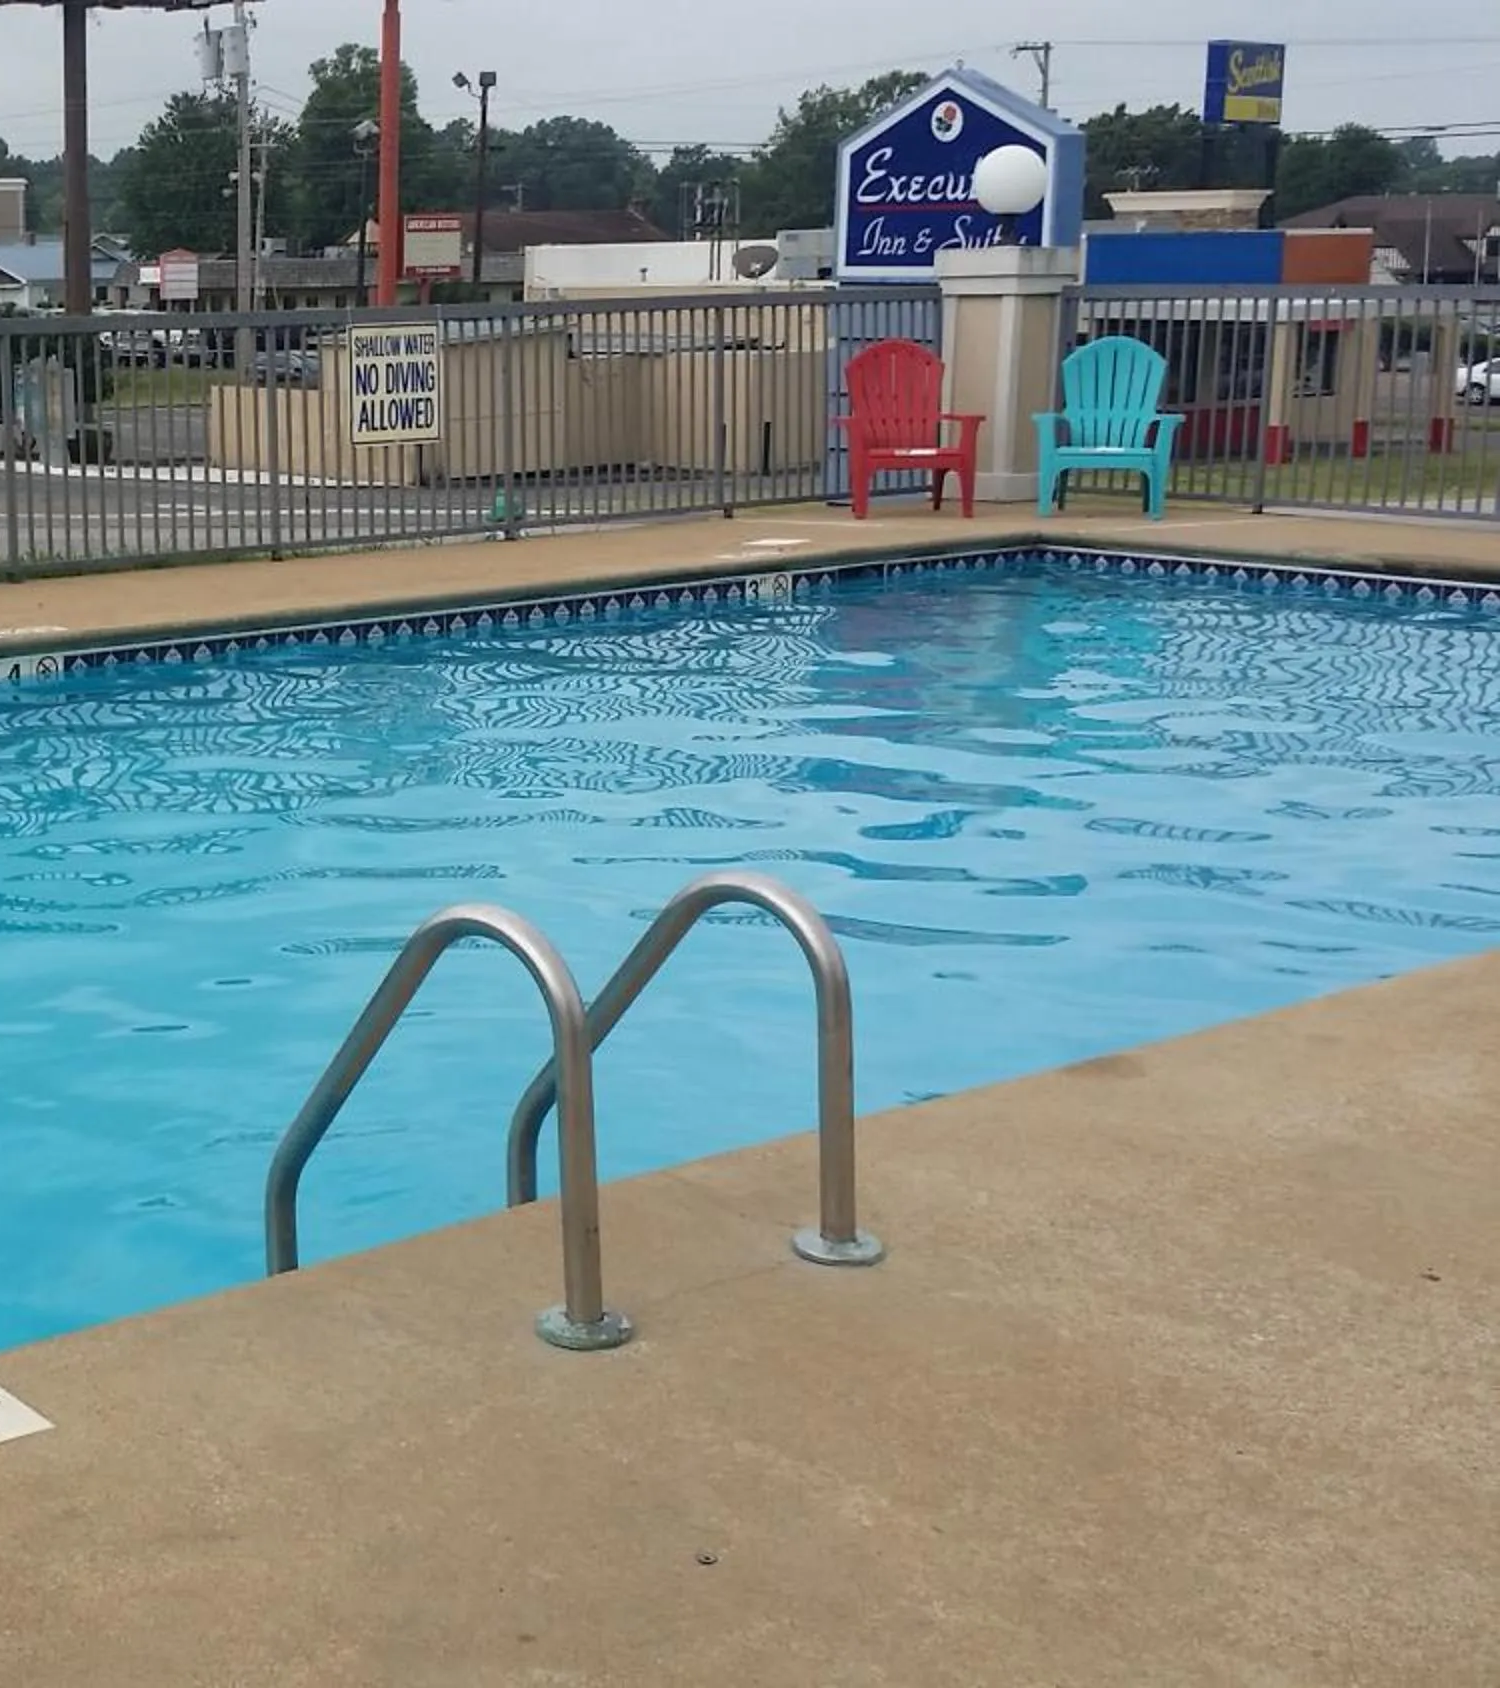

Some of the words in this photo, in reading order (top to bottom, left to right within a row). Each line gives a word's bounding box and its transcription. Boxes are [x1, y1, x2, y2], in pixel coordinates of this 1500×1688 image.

[857, 216, 907, 255] Inn
[914, 228, 933, 252] &
[354, 335, 400, 358] SHALLOW
[404, 333, 435, 356] WATER
[355, 363, 379, 396] NO
[386, 361, 435, 395] DIVING
[358, 397, 435, 432] ALLOWED
